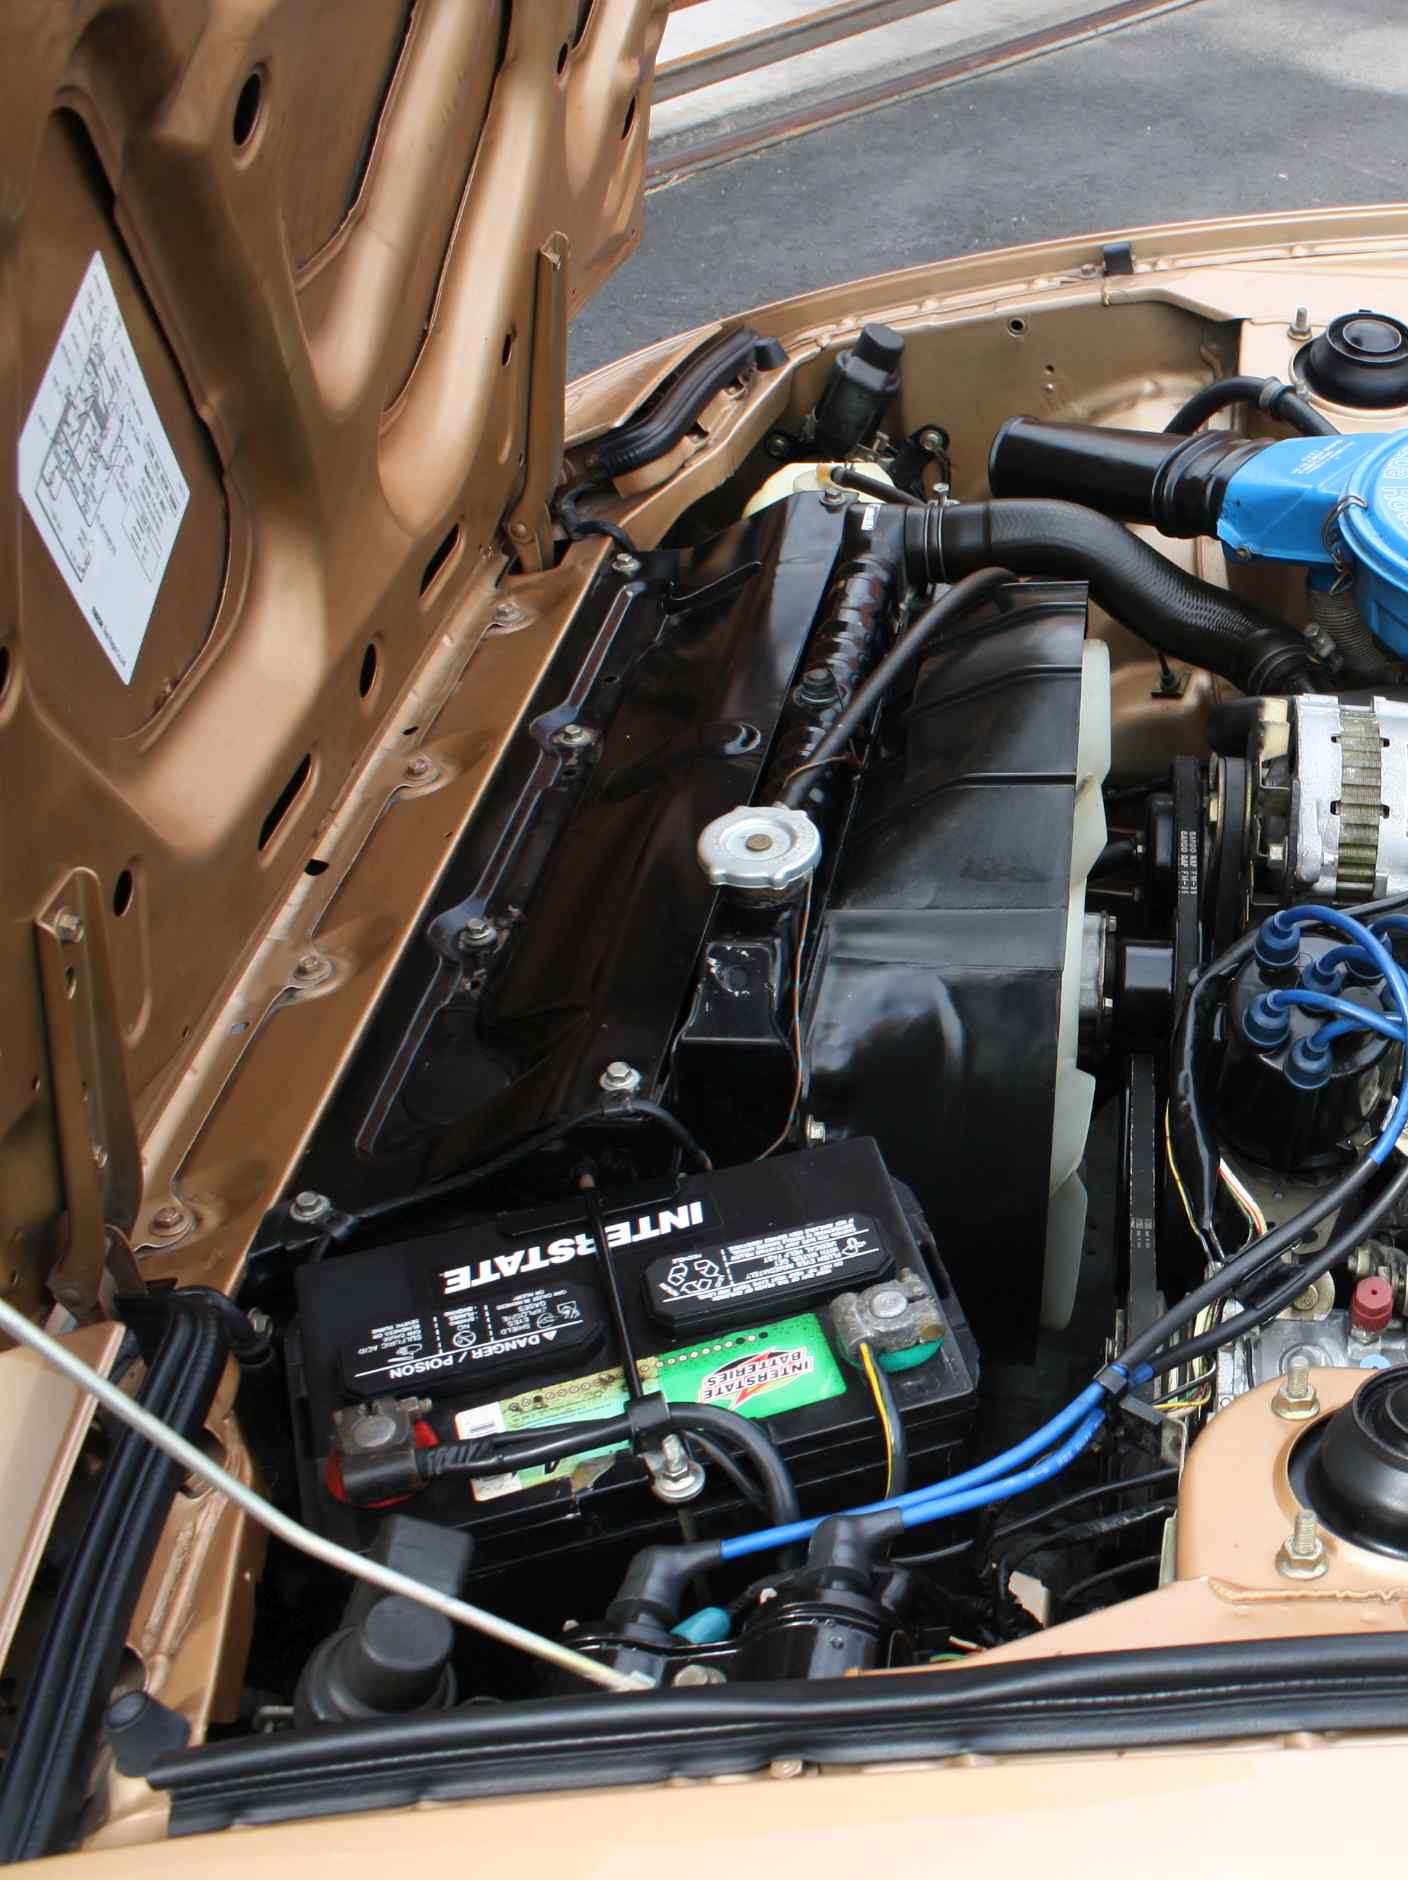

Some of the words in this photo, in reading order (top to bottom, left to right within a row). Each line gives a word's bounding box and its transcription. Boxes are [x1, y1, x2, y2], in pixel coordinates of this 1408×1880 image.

[443, 1201, 703, 1294] INTERSTATE
[471, 1335, 541, 1360] DANGER
[389, 1356, 454, 1379] POISON
[703, 1360, 811, 1400] INTERSTATE
[708, 1351, 801, 1388] BATTERIES
